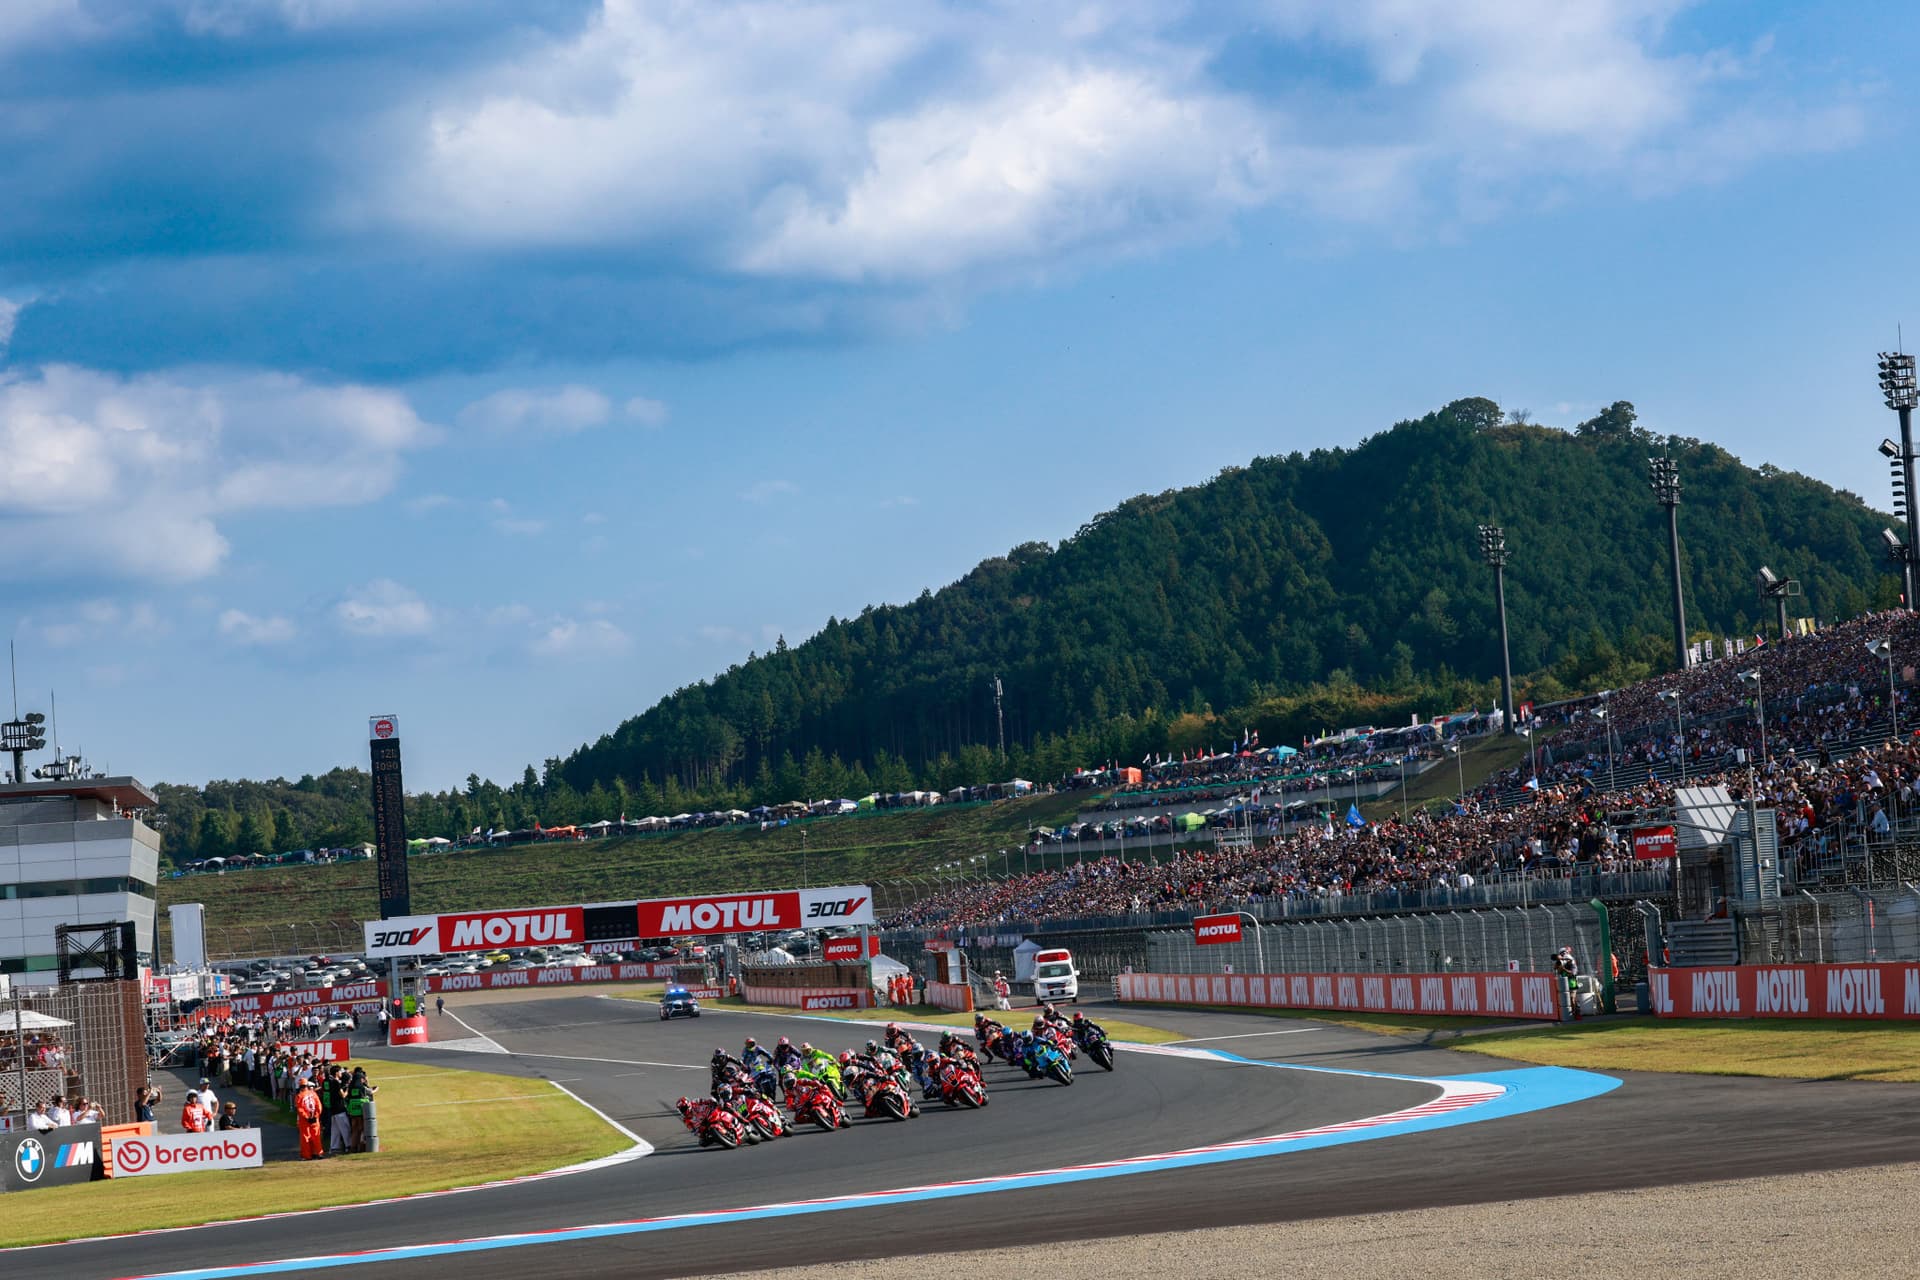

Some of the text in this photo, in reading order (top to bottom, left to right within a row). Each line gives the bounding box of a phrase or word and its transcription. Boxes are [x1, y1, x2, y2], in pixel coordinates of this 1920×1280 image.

[1636, 834, 1673, 846] MOTUL
[371, 897, 867, 948] 300V MOTUL MOTUL 300V
[1199, 924, 1239, 936] MOTUL
[590, 942, 635, 954] MOTUL
[828, 944, 858, 954] MOTUL
[441, 974, 483, 991] MOTUL
[491, 971, 529, 987] MOTUL
[537, 967, 579, 983] MOTUL
[581, 965, 613, 980] MOTUL
[619, 963, 648, 978] MOTUL
[654, 964, 673, 977] MOTU
[272, 991, 320, 1008] MOTUL
[332, 983, 378, 1001] MOTUL
[1391, 977, 1414, 1011] MOTUL
[1420, 977, 1445, 1012] MOTUL
[1451, 976, 1478, 1012] MOTUL
[1485, 976, 1514, 1013] MOTUL
[1521, 977, 1553, 1015] MOTUL
[1692, 971, 1740, 1013] MOTUL
[1756, 969, 1809, 1014] MOTUL
[1827, 968, 1885, 1015] MOTUL
[807, 996, 853, 1009] MOTUL
[396, 1026, 425, 1036] MOTUL
[156, 1140, 257, 1164] brembo
